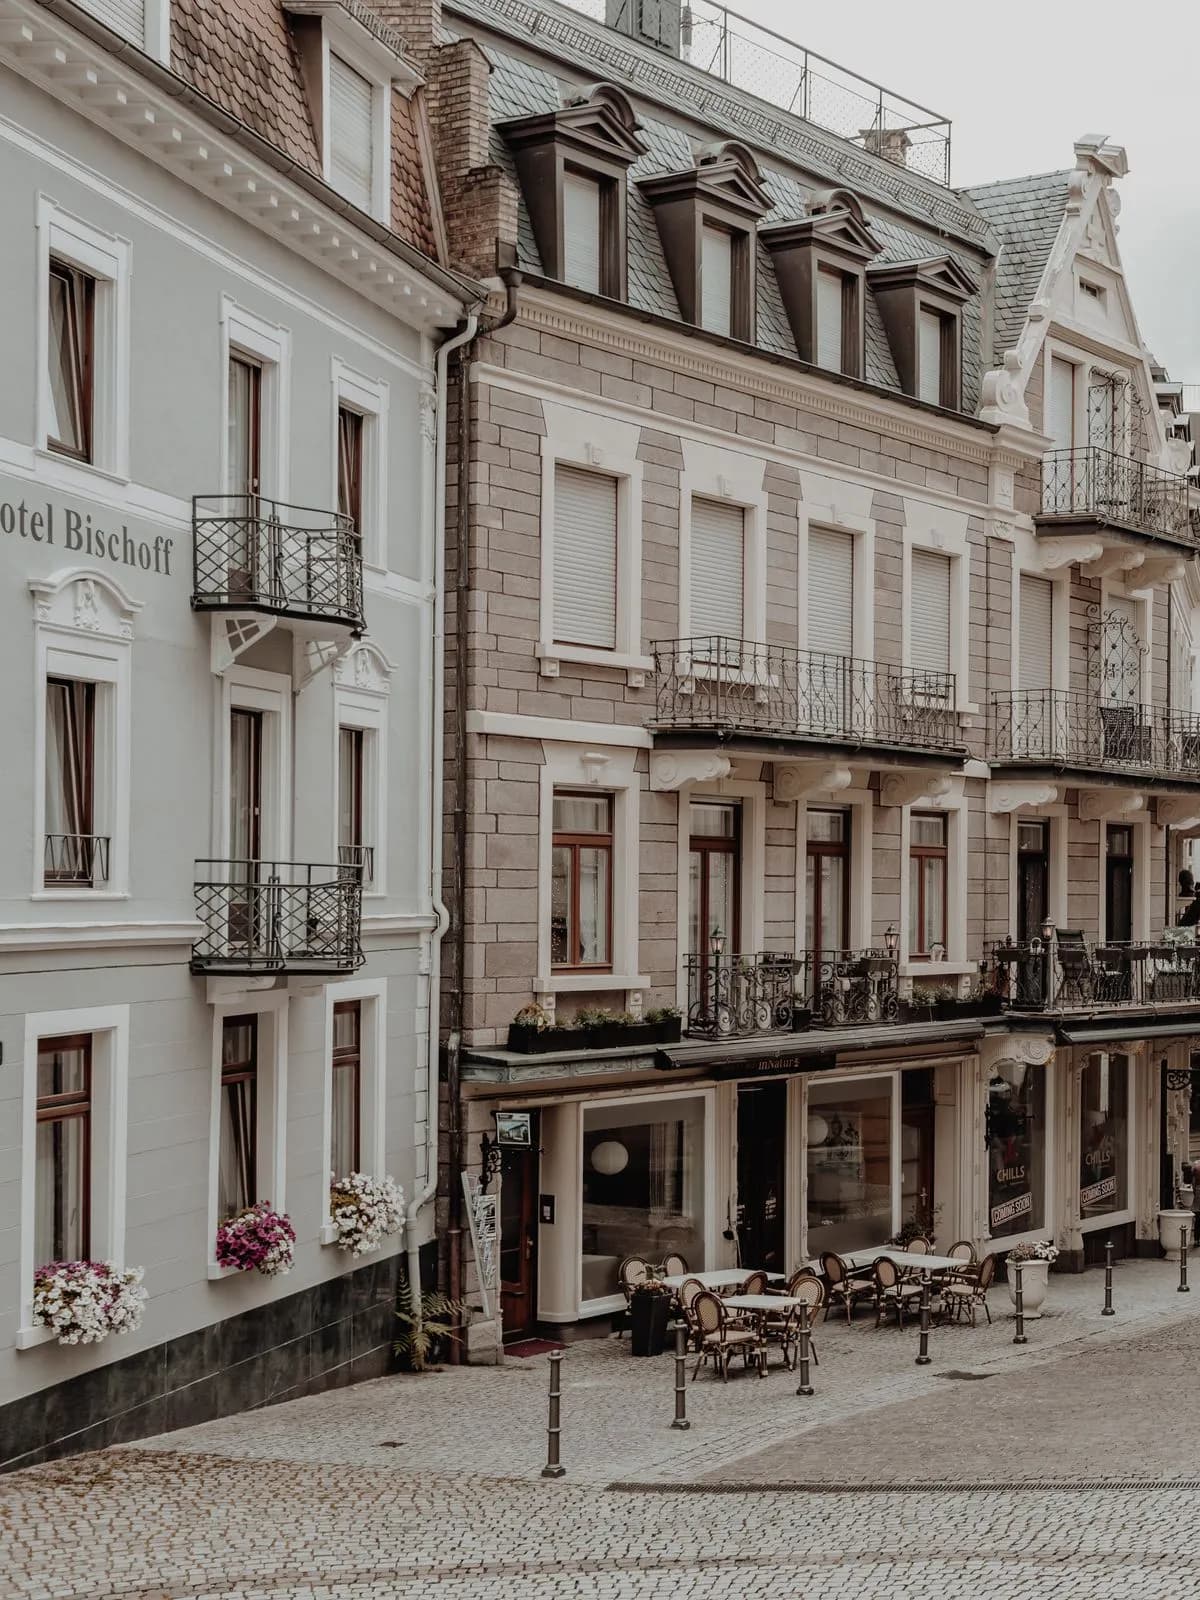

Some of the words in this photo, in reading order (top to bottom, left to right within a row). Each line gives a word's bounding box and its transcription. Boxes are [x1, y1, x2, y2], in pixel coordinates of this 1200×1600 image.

[64, 508, 173, 576] Bischoff
[997, 1166, 1025, 1182] CHILLS
[1102, 1180, 1114, 1194] SOON
[994, 1204, 1015, 1222] COMING
[1015, 1197, 1030, 1212] SOON
